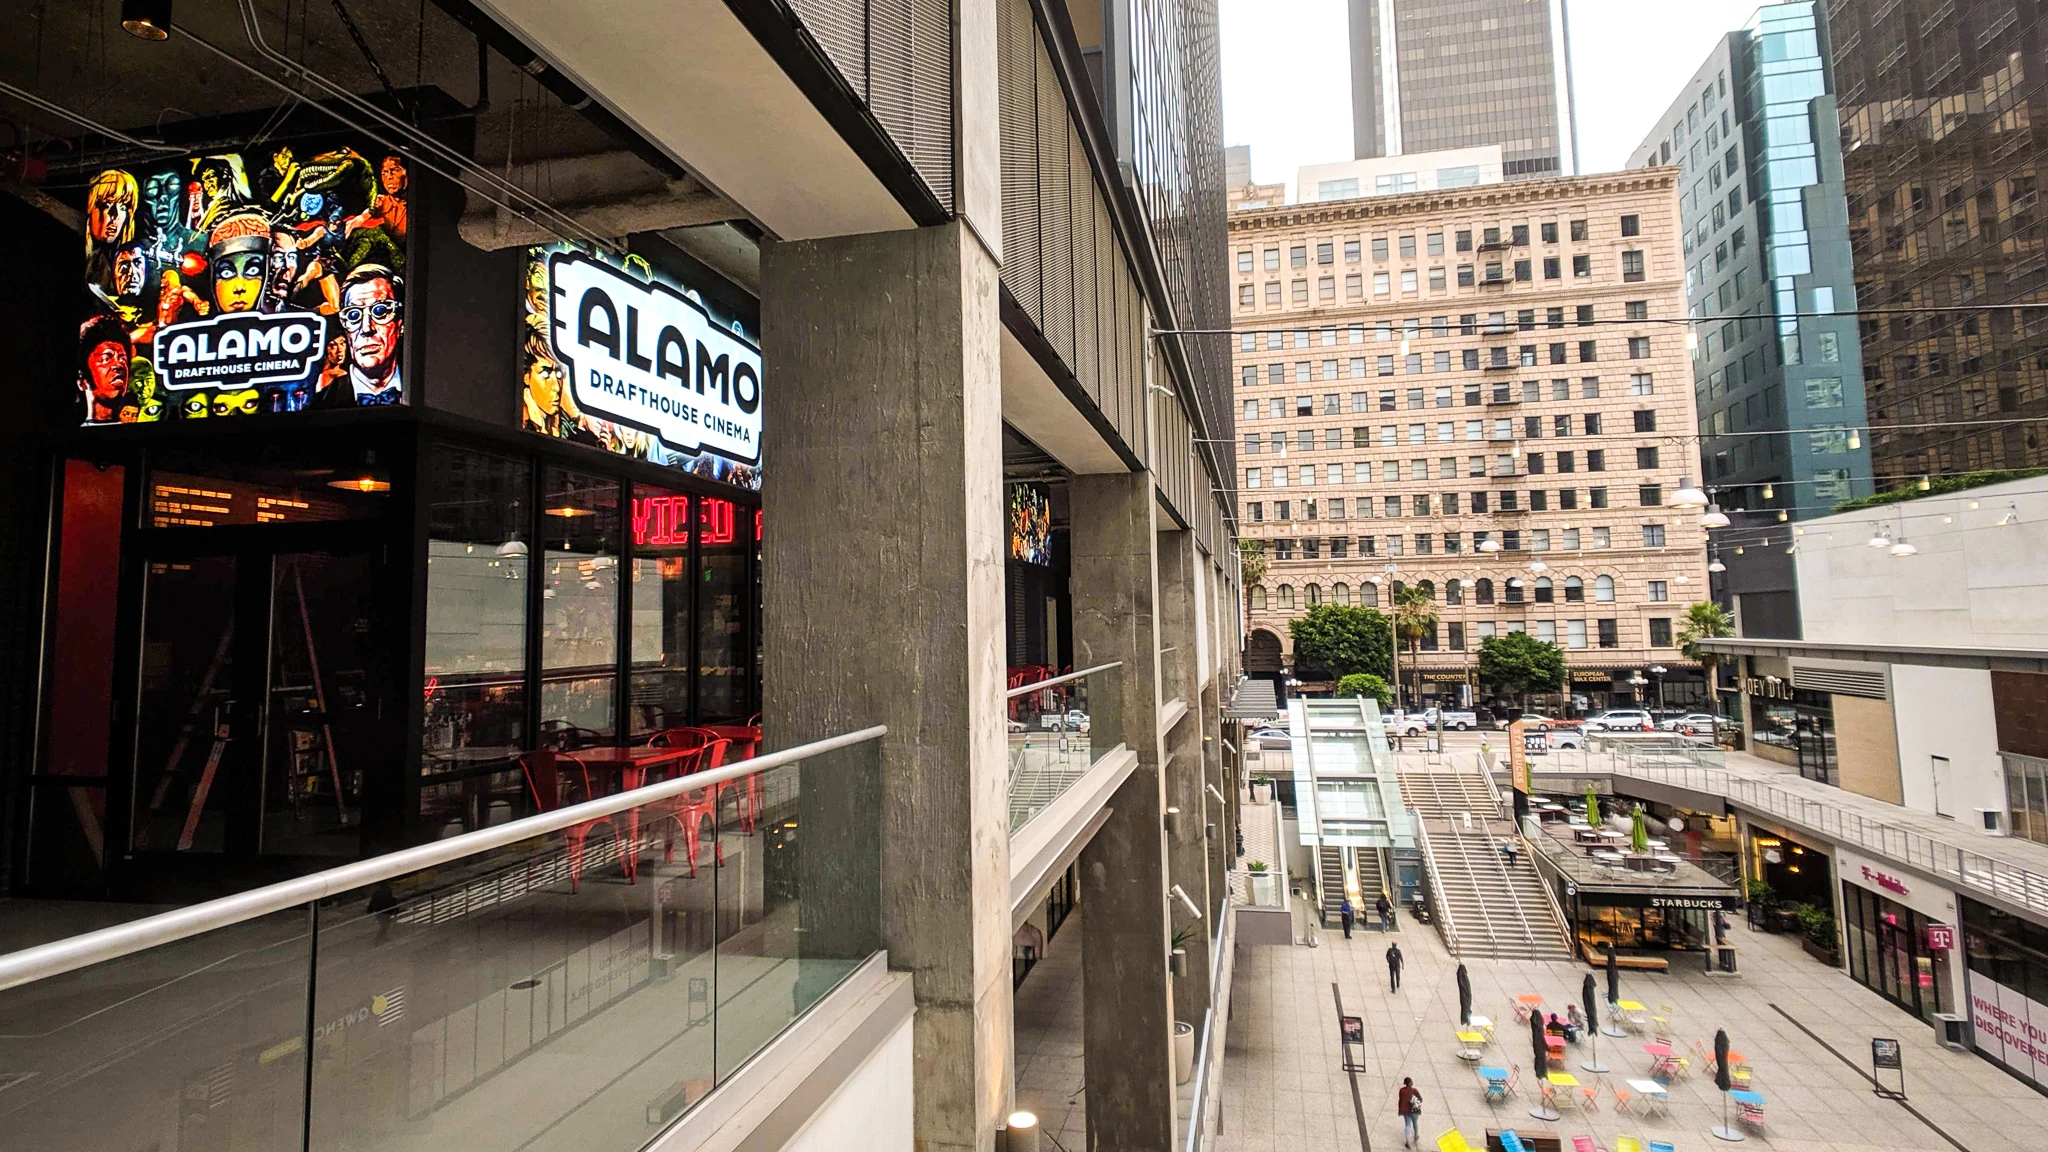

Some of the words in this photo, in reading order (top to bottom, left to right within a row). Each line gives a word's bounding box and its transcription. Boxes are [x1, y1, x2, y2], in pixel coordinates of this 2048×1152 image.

[168, 323, 312, 364] ALAMO
[578, 286, 760, 414] ALAMO
[174, 362, 252, 379] DRAFTHOUSE
[254, 358, 300, 372] CINEMA
[590, 368, 699, 425] DRAFTHOUSE
[703, 412, 751, 443] CINEMA
[1741, 677, 1765, 696] JOEY
[1513, 728, 1525, 784] STARBUCKS
[1652, 898, 1723, 909] STARBUCKS
[1973, 995, 2017, 1029] WHERE
[2019, 1019, 2047, 1044] YOU
